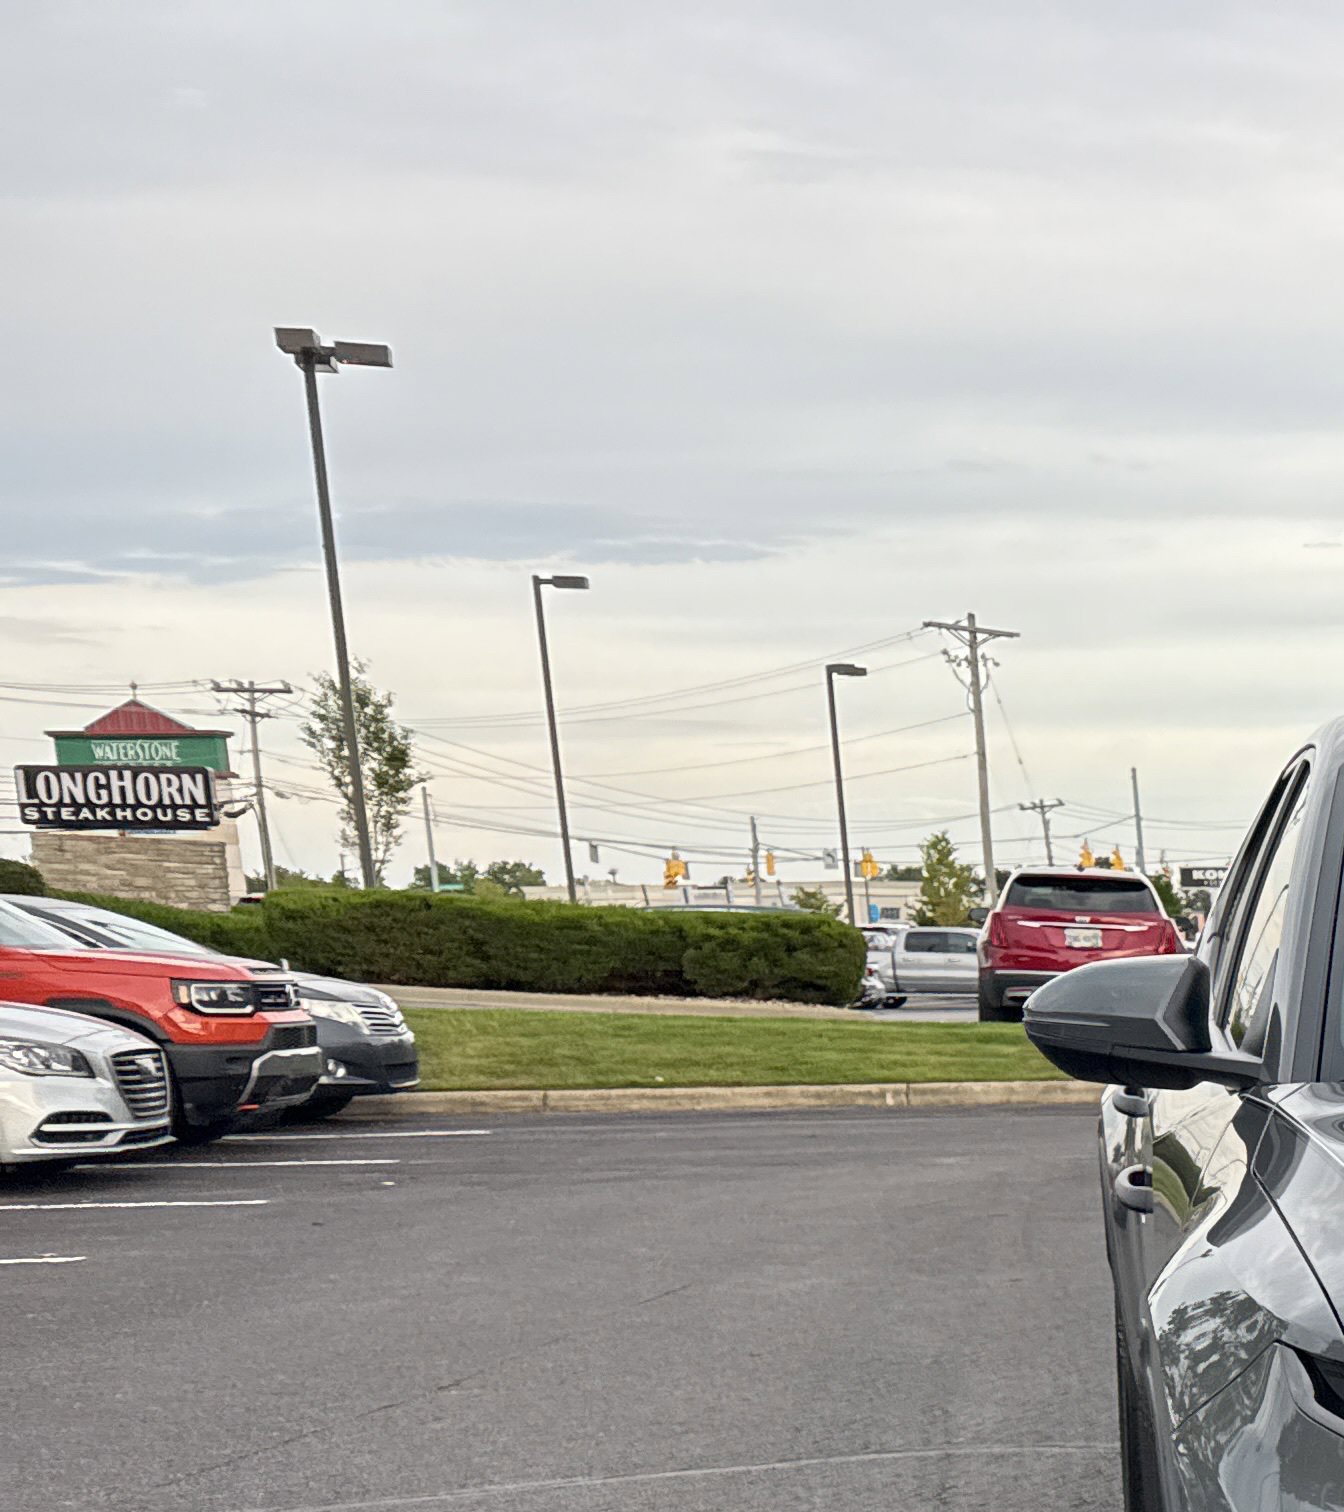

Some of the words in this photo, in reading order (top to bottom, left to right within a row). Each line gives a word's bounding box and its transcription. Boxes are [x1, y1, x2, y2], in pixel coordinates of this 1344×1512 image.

[91, 739, 181, 762] WATERSTONE
[16, 769, 207, 805] LONGHORN
[24, 807, 211, 822] STEAKHOUSE
